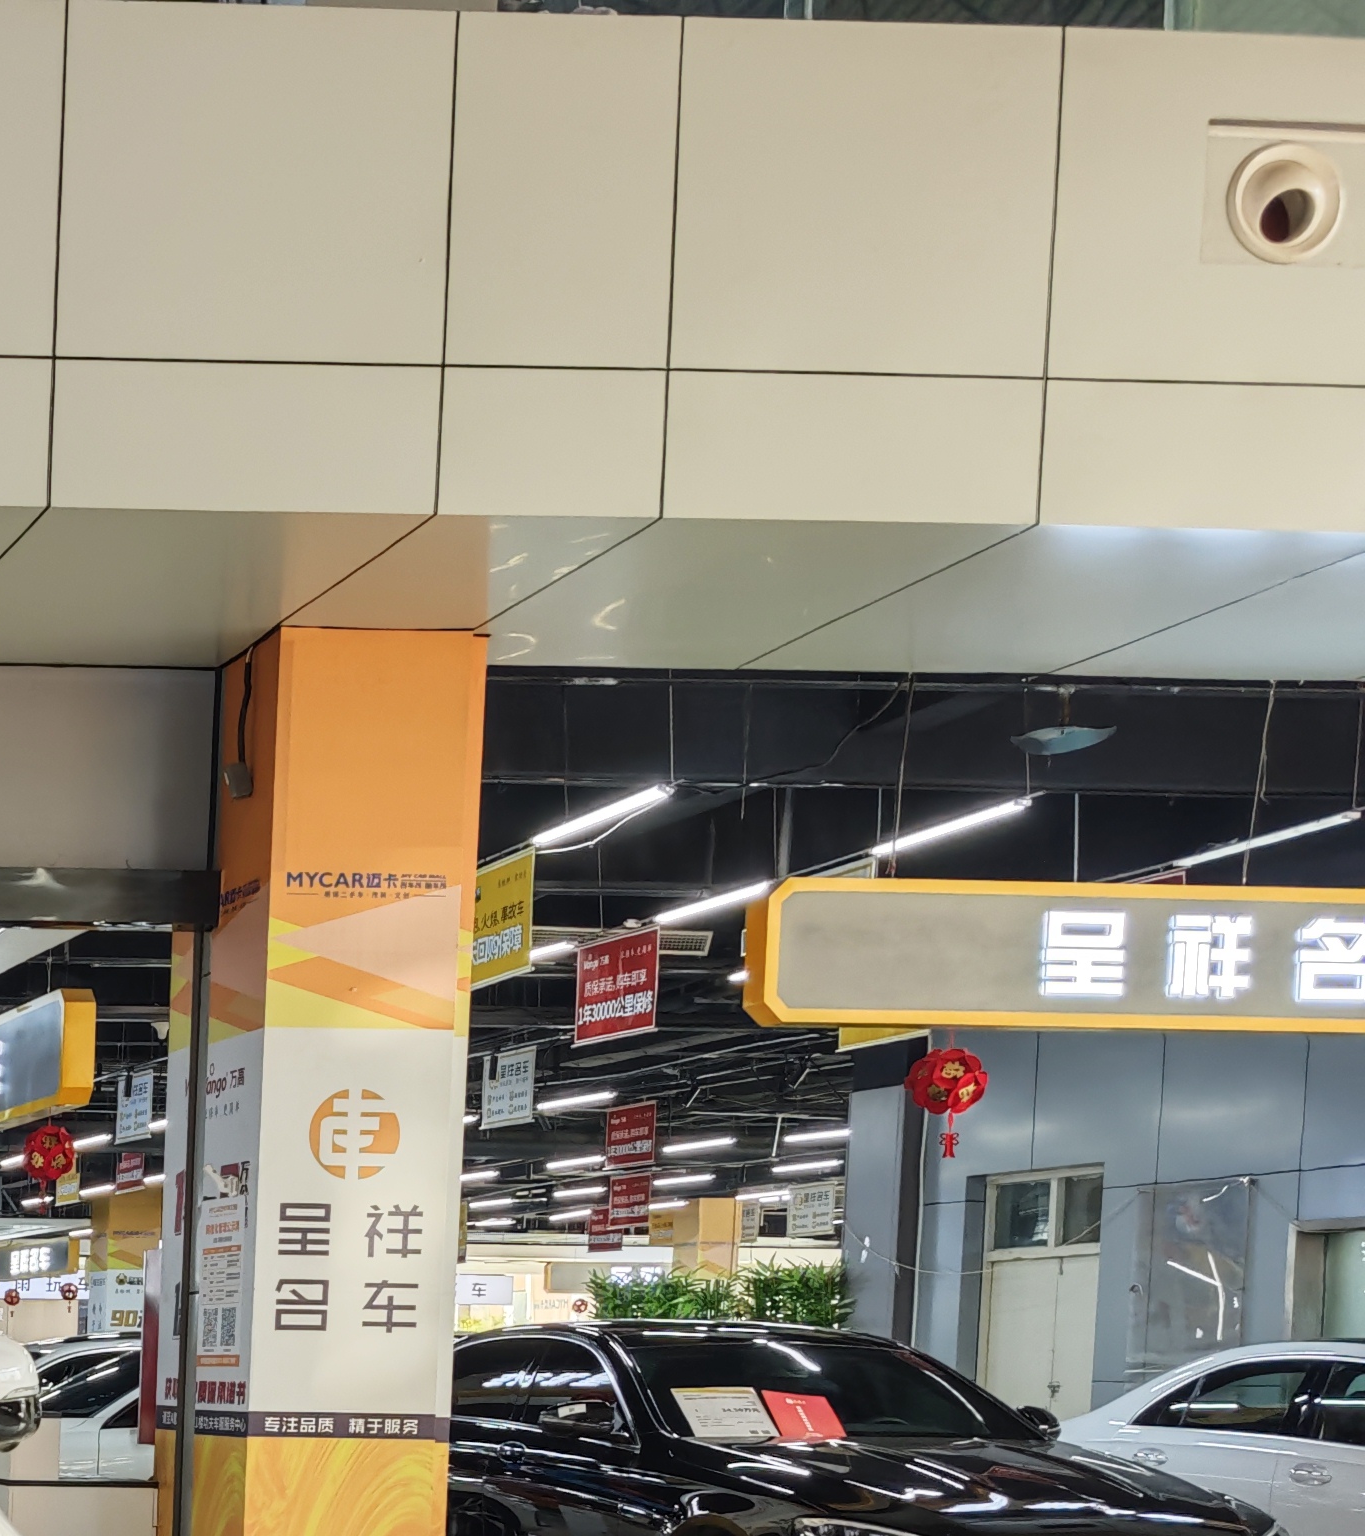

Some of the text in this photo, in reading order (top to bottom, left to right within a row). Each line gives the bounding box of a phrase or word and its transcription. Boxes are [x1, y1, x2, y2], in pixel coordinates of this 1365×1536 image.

[577, 989, 655, 1027] 1年30000公里保修
[229, 1066, 246, 1089] 万高
[277, 1202, 424, 1259] 呈祥
[274, 1278, 420, 1334] 名车
[264, 1416, 419, 1436] 专注品质 精于服务
